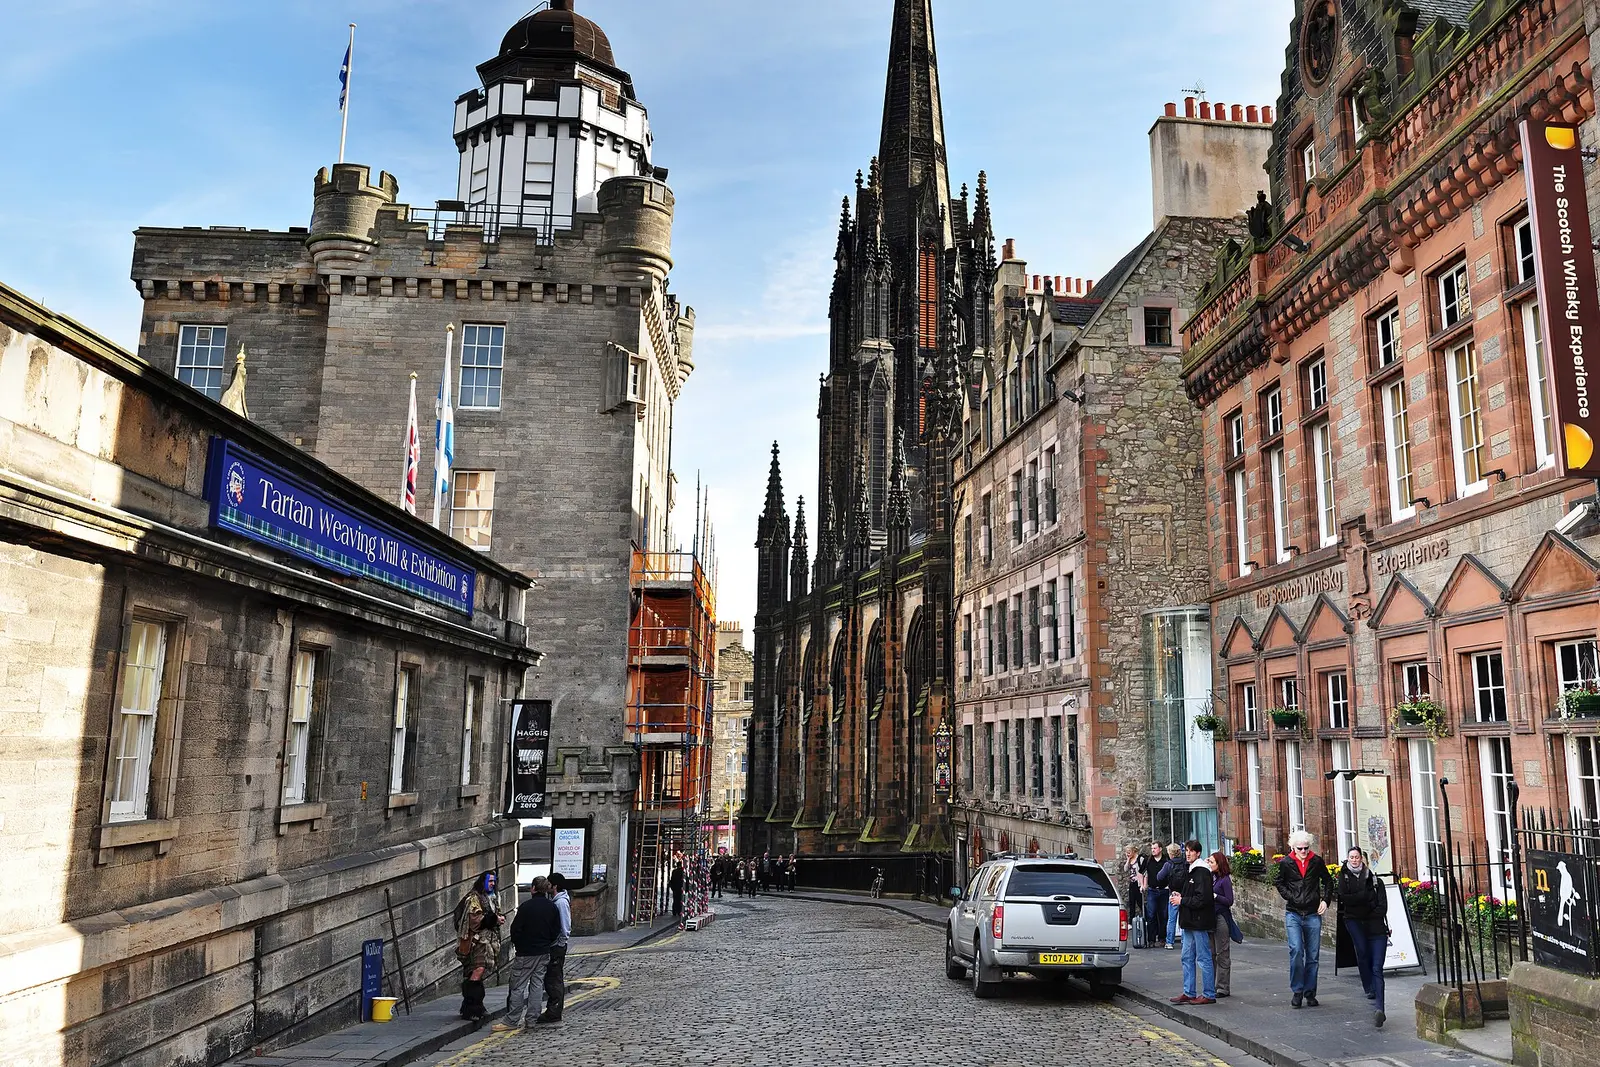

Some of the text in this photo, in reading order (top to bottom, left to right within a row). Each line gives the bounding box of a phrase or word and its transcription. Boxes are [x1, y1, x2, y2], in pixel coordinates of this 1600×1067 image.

[1305, 206, 1326, 238] HILL
[1329, 174, 1362, 214] SCHOO
[1552, 164, 1590, 419] The Scotch Whisky Experience
[259, 477, 314, 530] Tartan
[319, 508, 377, 563] Weaving
[379, 537, 399, 567] Mill
[400, 549, 409, 571] &
[410, 552, 457, 592] Exhibition
[1375, 538, 1450, 576] Experience
[1254, 569, 1344, 609] The Scotch Whisky
[1535, 868, 1551, 892] n
[1042, 954, 1079, 963] ST07 LZK
